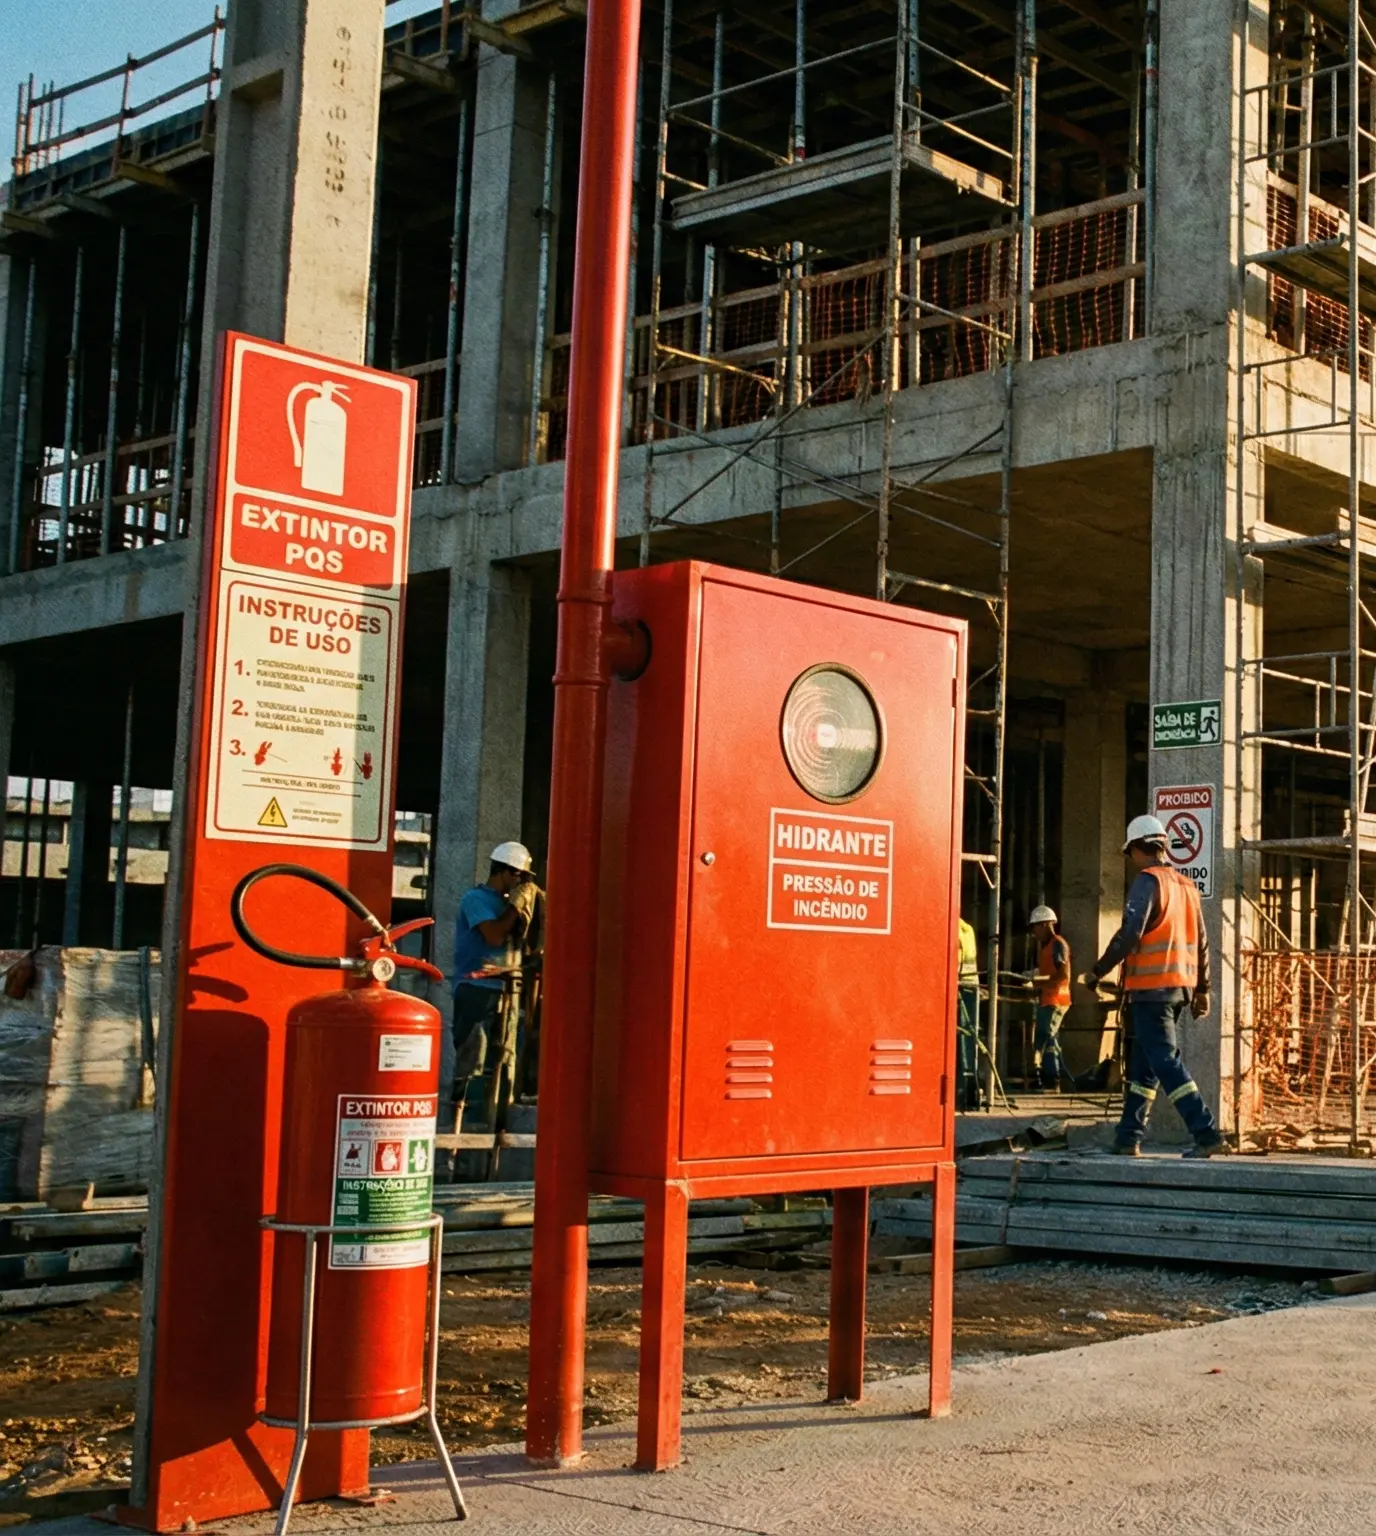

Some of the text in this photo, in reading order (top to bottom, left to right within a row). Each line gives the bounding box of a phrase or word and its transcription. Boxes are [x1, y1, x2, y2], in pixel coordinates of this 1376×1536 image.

[241, 503, 388, 553] EXTINTOR
[286, 542, 344, 574] PQS
[238, 595, 382, 635] INSTRUÇÕES
[269, 626, 351, 654] DE USO
[233, 659, 251, 676] 1.
[231, 699, 249, 716] 2.
[229, 739, 246, 756] 3.
[777, 823, 887, 858] HIDRANTE
[783, 873, 879, 898] PRESSÃO DE
[794, 896, 868, 921] INCÊNDIO
[346, 1101, 411, 1116] EXTINTOR
